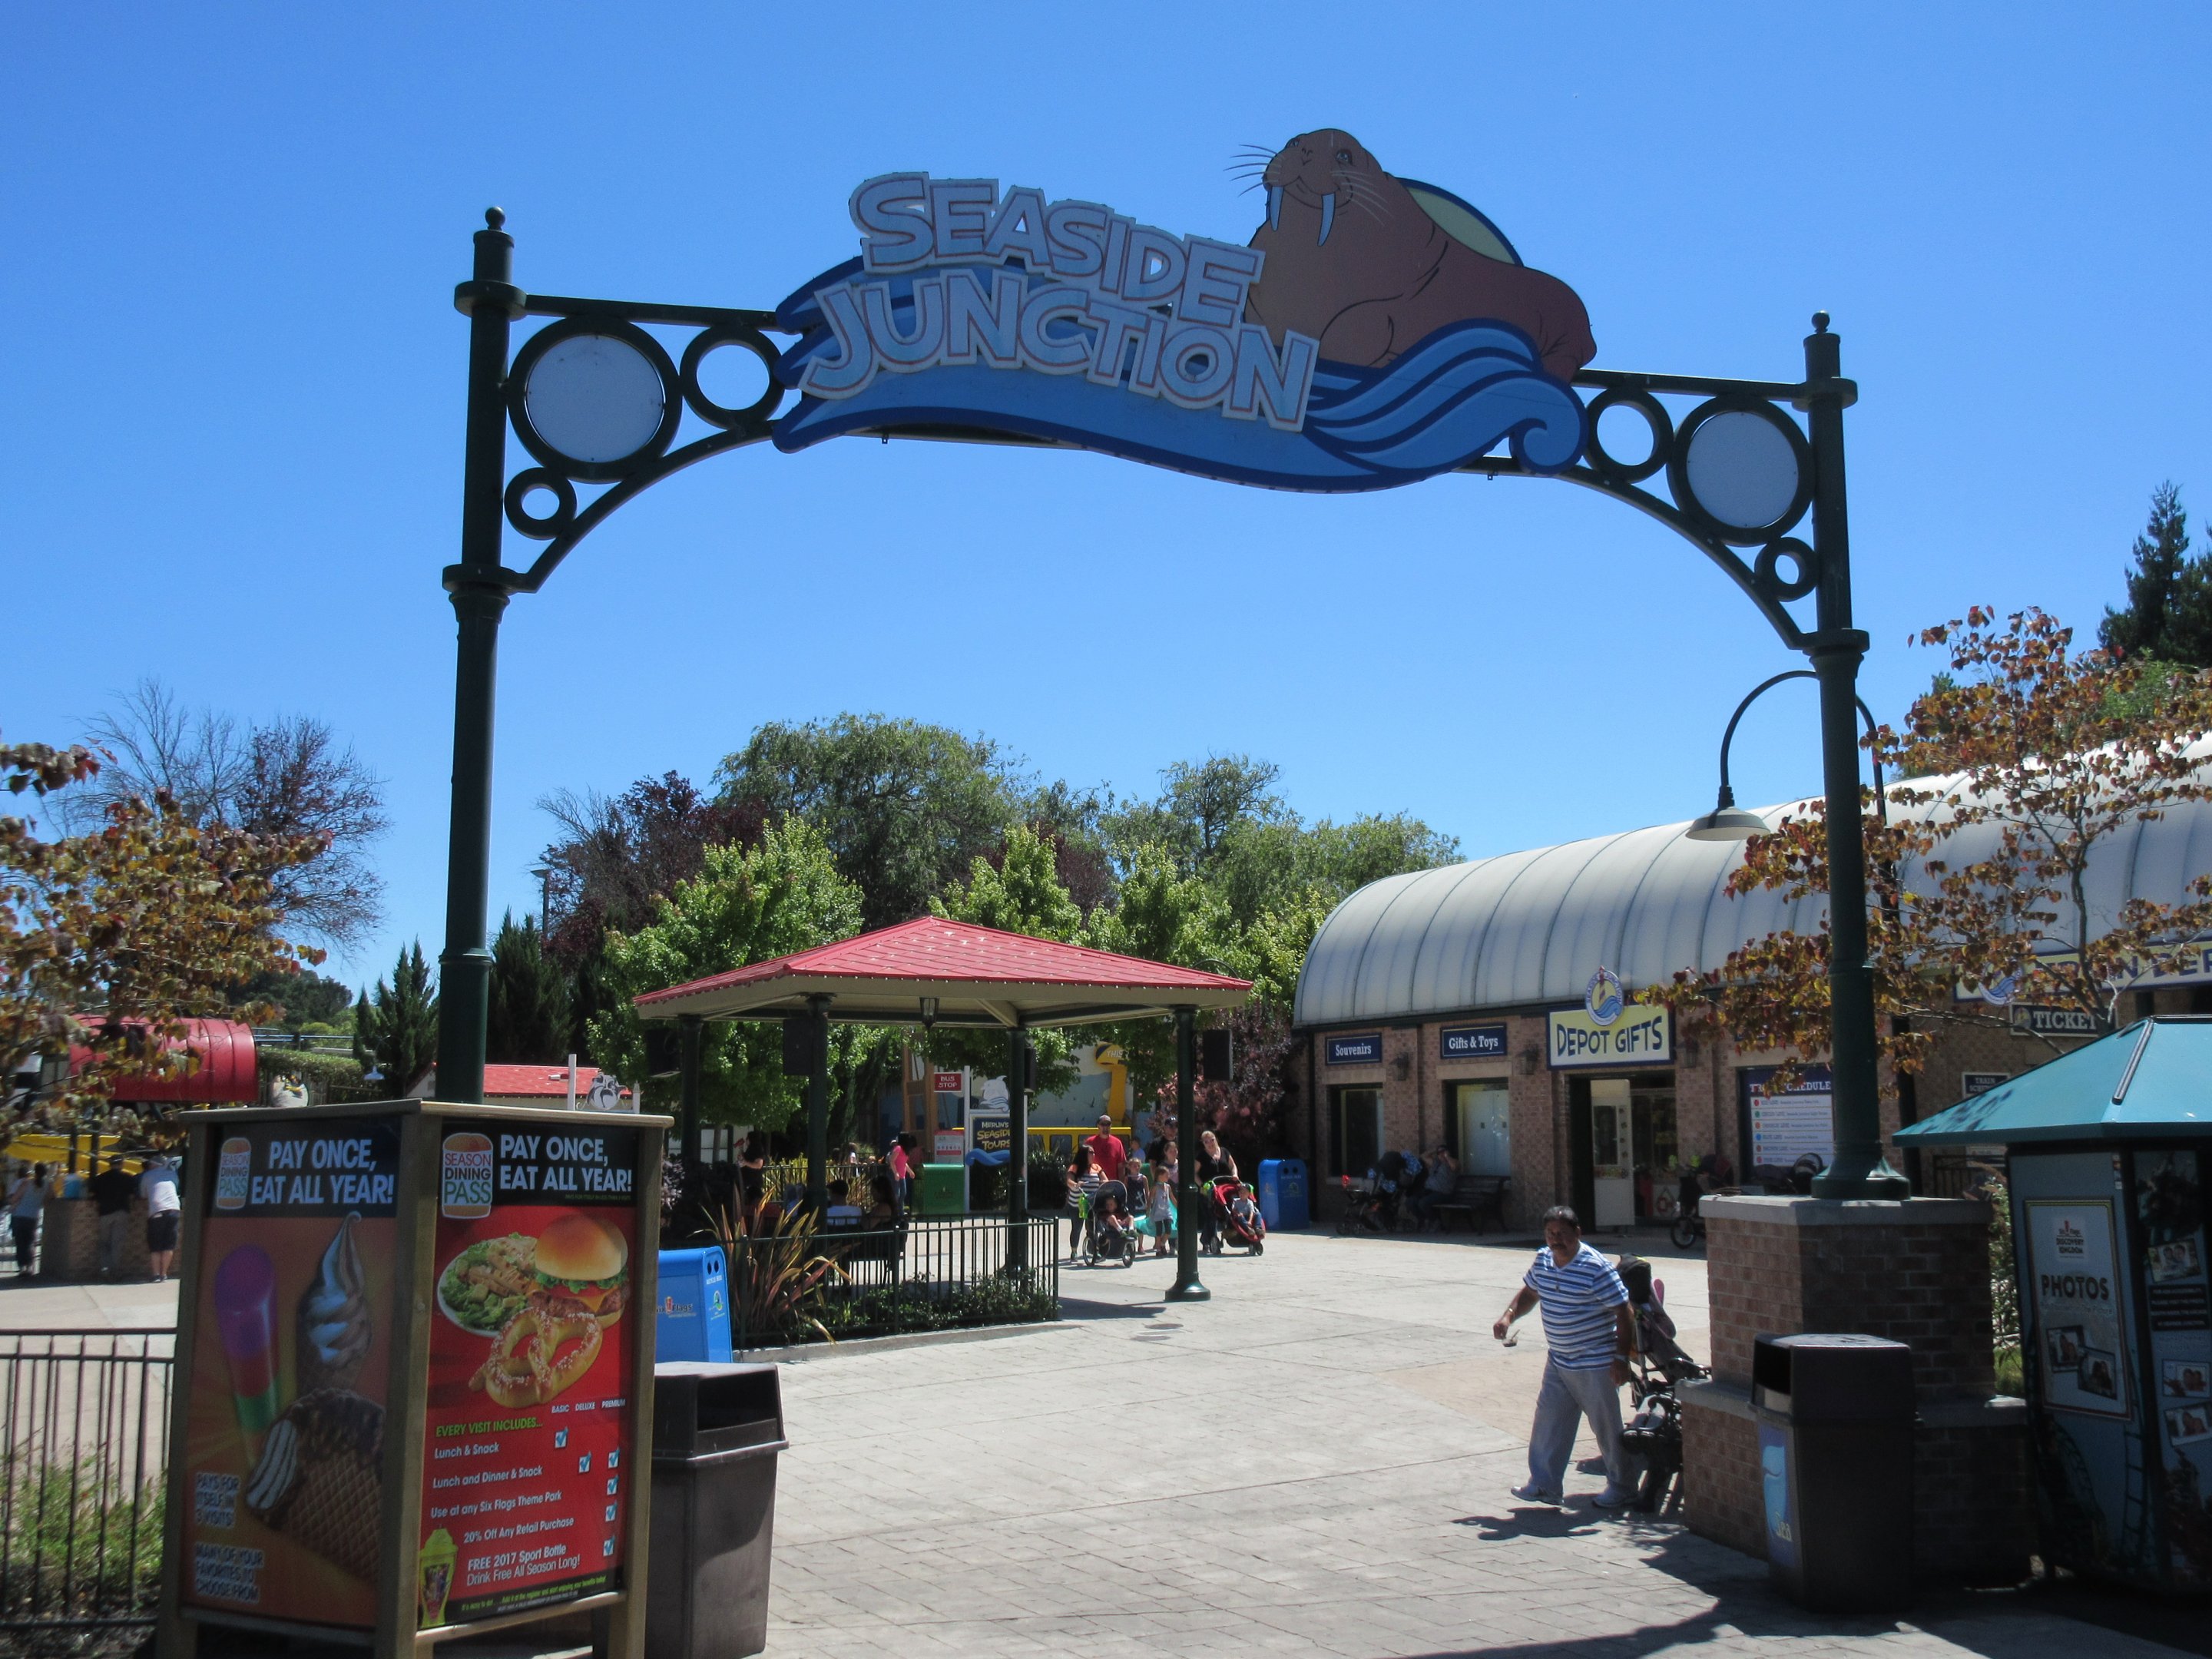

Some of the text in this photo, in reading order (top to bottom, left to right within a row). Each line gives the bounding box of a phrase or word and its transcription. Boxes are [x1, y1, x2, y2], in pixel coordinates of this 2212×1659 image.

[849, 172, 1265, 328] SEASIDE
[799, 268, 1319, 432] JUNCTION
[1449, 1035, 1498, 1050] Gifts & Toys
[1557, 1015, 1662, 1056] DEPOT GIFTS
[1336, 1043, 1372, 1056] Souvenirs
[977, 1129, 1010, 1140] SEASID
[222, 1154, 250, 1168] SEASON
[270, 1139, 376, 1172] PAY ONCE,
[445, 1153, 492, 1167] SEASON
[501, 1134, 608, 1167] PAY ONCE,
[220, 1167, 247, 1178] DINING
[445, 1168, 492, 1180] DINING
[500, 1165, 632, 1191] EAT ALL YEAR!
[219, 1177, 247, 1197] PASS
[251, 1174, 395, 1204] EAT ALL YEAR!
[444, 1181, 492, 1204] PASS
[2041, 1274, 2110, 1301] PHOTOS
[551, 1399, 626, 1414] BASIC DELUXE PREMIUM
[435, 1418, 544, 1438] EVERY VISIT INCLUDES...
[435, 1441, 500, 1459] Lunch & Snack
[432, 1465, 543, 1489] Lunch and Dinner & Snack
[431, 1490, 562, 1519] Use at any Six Flags Theme Park
[463, 1517, 575, 1544] 20% Off Any Retail Purchase
[468, 1543, 567, 1571] FREE 2017 Sport Bottle
[467, 1554, 581, 1587] Drink Free All Season Long!
